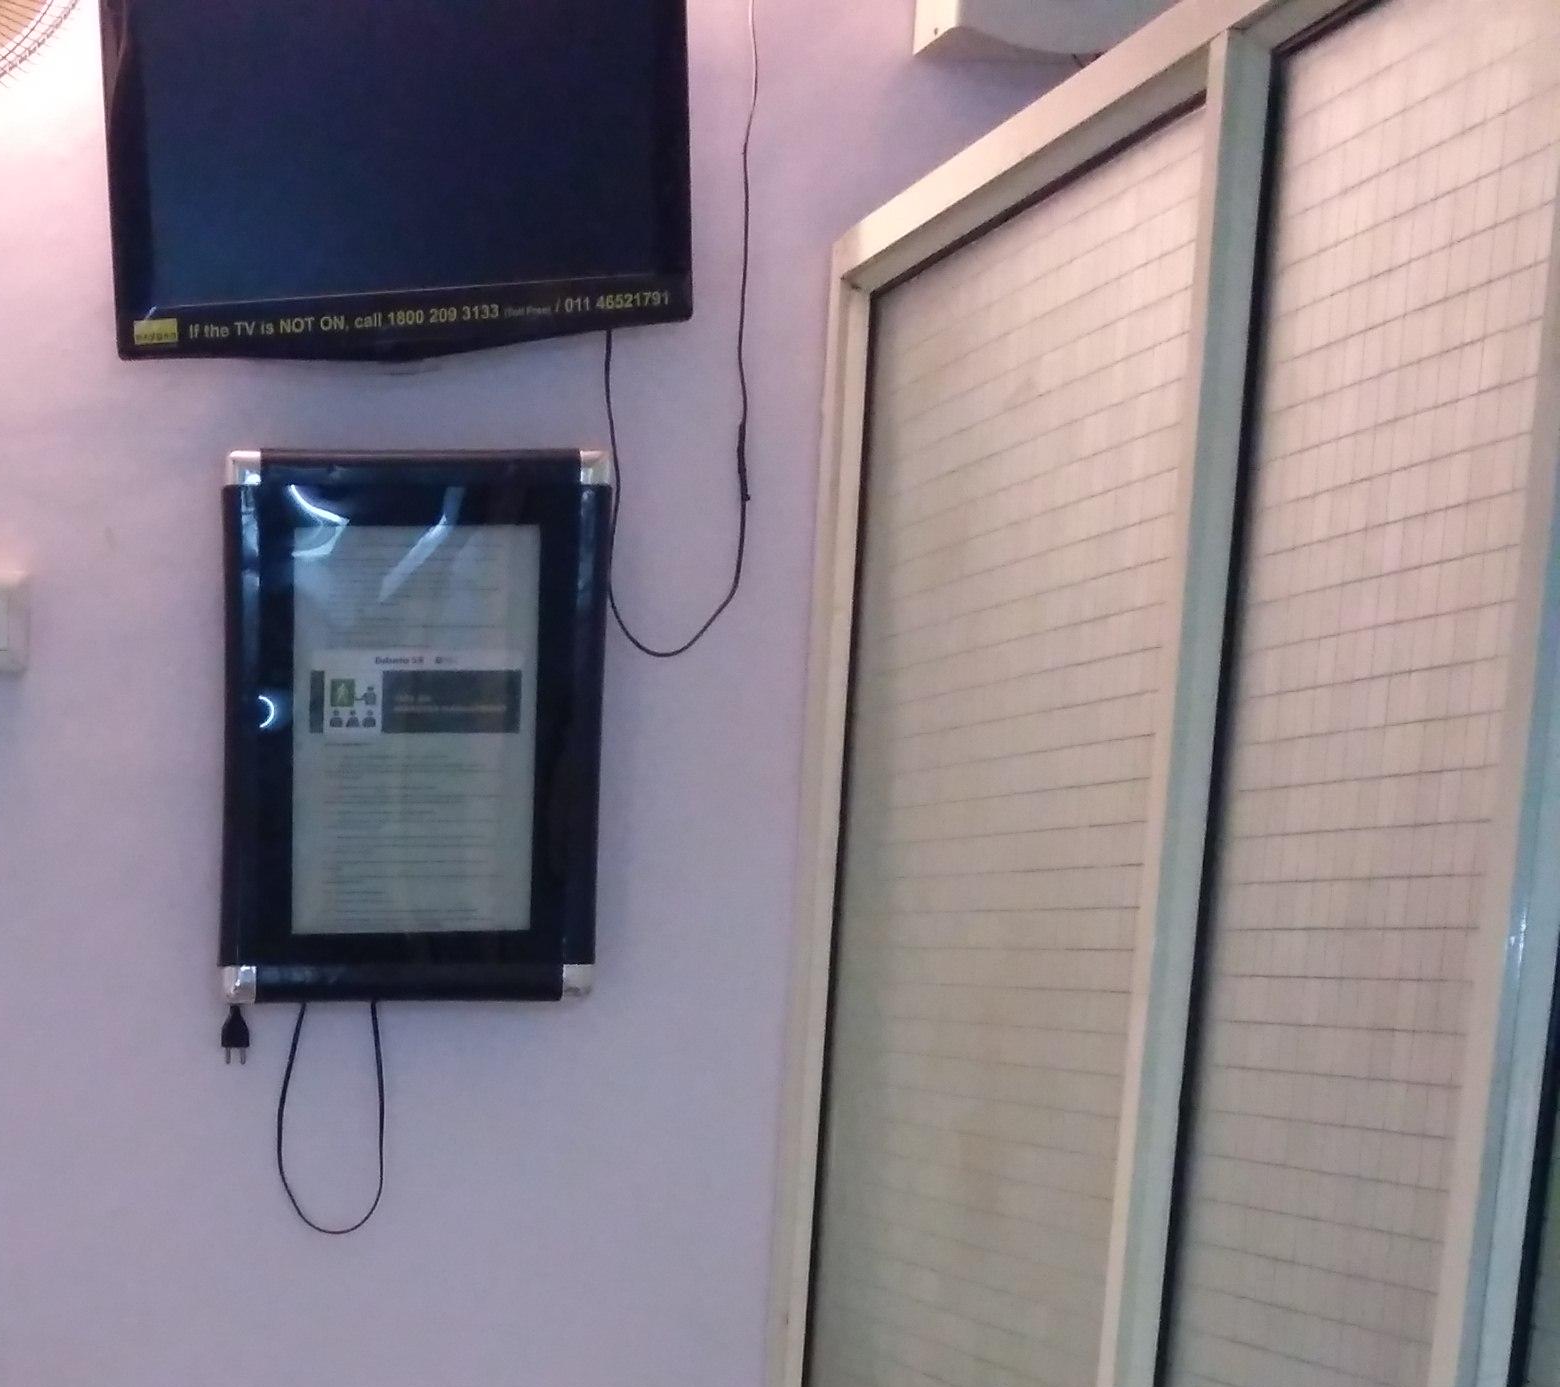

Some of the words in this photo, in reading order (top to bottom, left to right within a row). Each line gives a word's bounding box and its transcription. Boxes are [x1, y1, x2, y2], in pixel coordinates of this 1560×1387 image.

[189, 323, 199, 339] If
[204, 323, 230, 338] the
[234, 320, 256, 336] TV
[261, 321, 274, 335] is
[279, 317, 316, 334] NOT
[354, 312, 382, 328] call
[389, 309, 425, 326] 1800
[429, 307, 458, 323] 209
[462, 303, 500, 320] 3133
[564, 297, 590, 312] 011
[596, 290, 670, 310] 46521791
